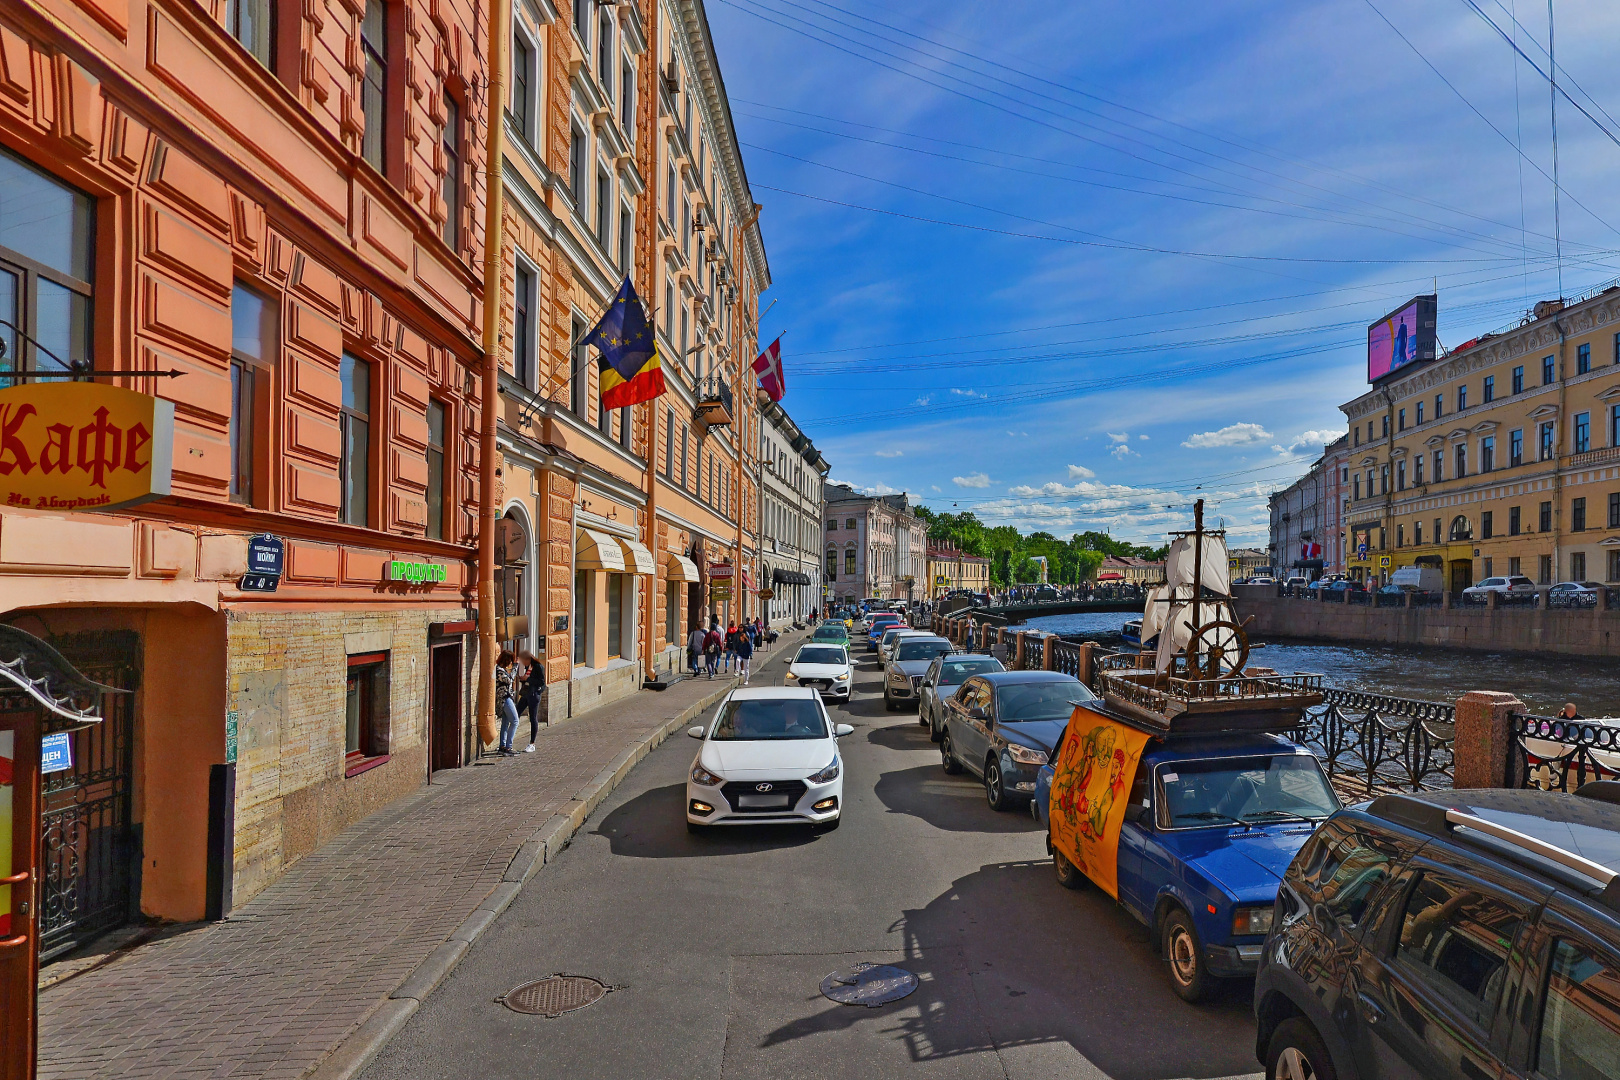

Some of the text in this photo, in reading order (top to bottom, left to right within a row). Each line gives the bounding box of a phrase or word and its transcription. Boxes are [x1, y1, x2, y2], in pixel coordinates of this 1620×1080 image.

[0, 403, 151, 489] Кафе
[7, 492, 111, 510] На Абордаж
[391, 561, 447, 585] ПРОДУКТЫ
